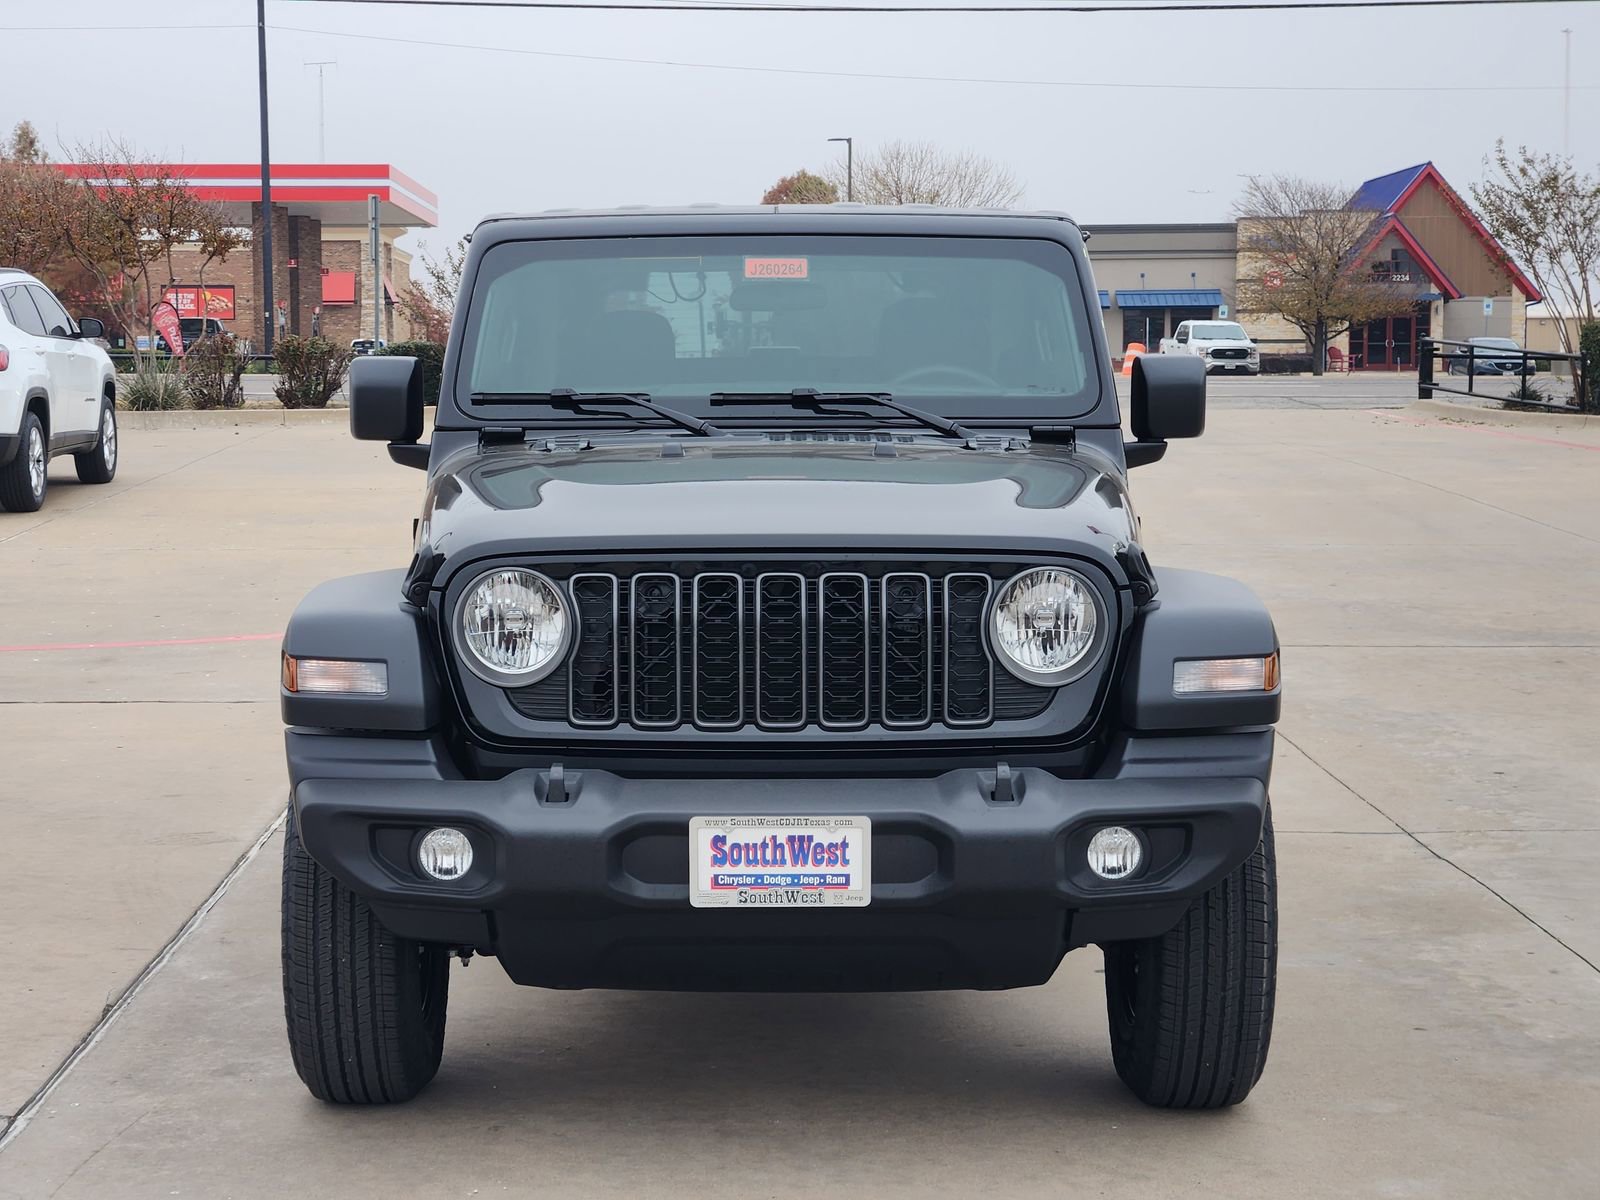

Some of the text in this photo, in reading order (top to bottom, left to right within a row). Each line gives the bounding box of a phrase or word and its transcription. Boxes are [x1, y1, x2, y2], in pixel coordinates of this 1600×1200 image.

[750, 262, 803, 276] J260264
[1391, 273, 1410, 282] 2234
[710, 834, 850, 868] SouthWest
[718, 875, 846, 885] Chrysler Dodge Jeep Ram
[738, 890, 824, 904] SouthWest
